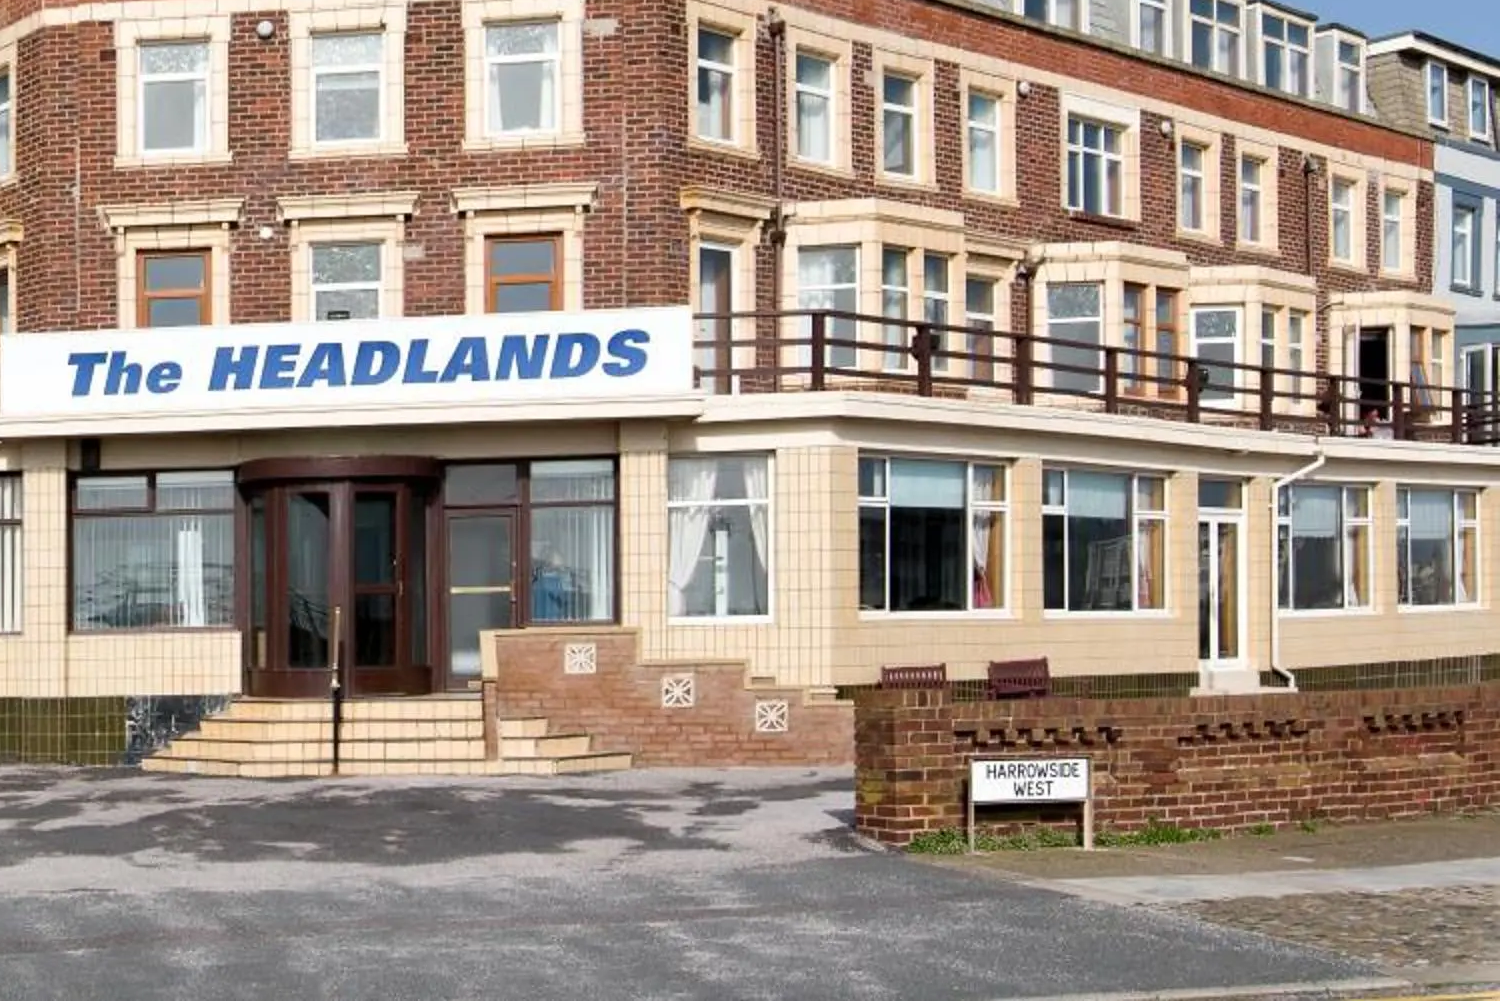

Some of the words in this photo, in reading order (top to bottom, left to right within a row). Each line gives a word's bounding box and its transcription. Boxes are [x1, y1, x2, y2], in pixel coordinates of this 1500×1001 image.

[67, 351, 182, 396] The
[209, 329, 649, 391] HEADLANDS
[986, 762, 1081, 779] HARROWSIDE
[1013, 780, 1054, 797] WEST
